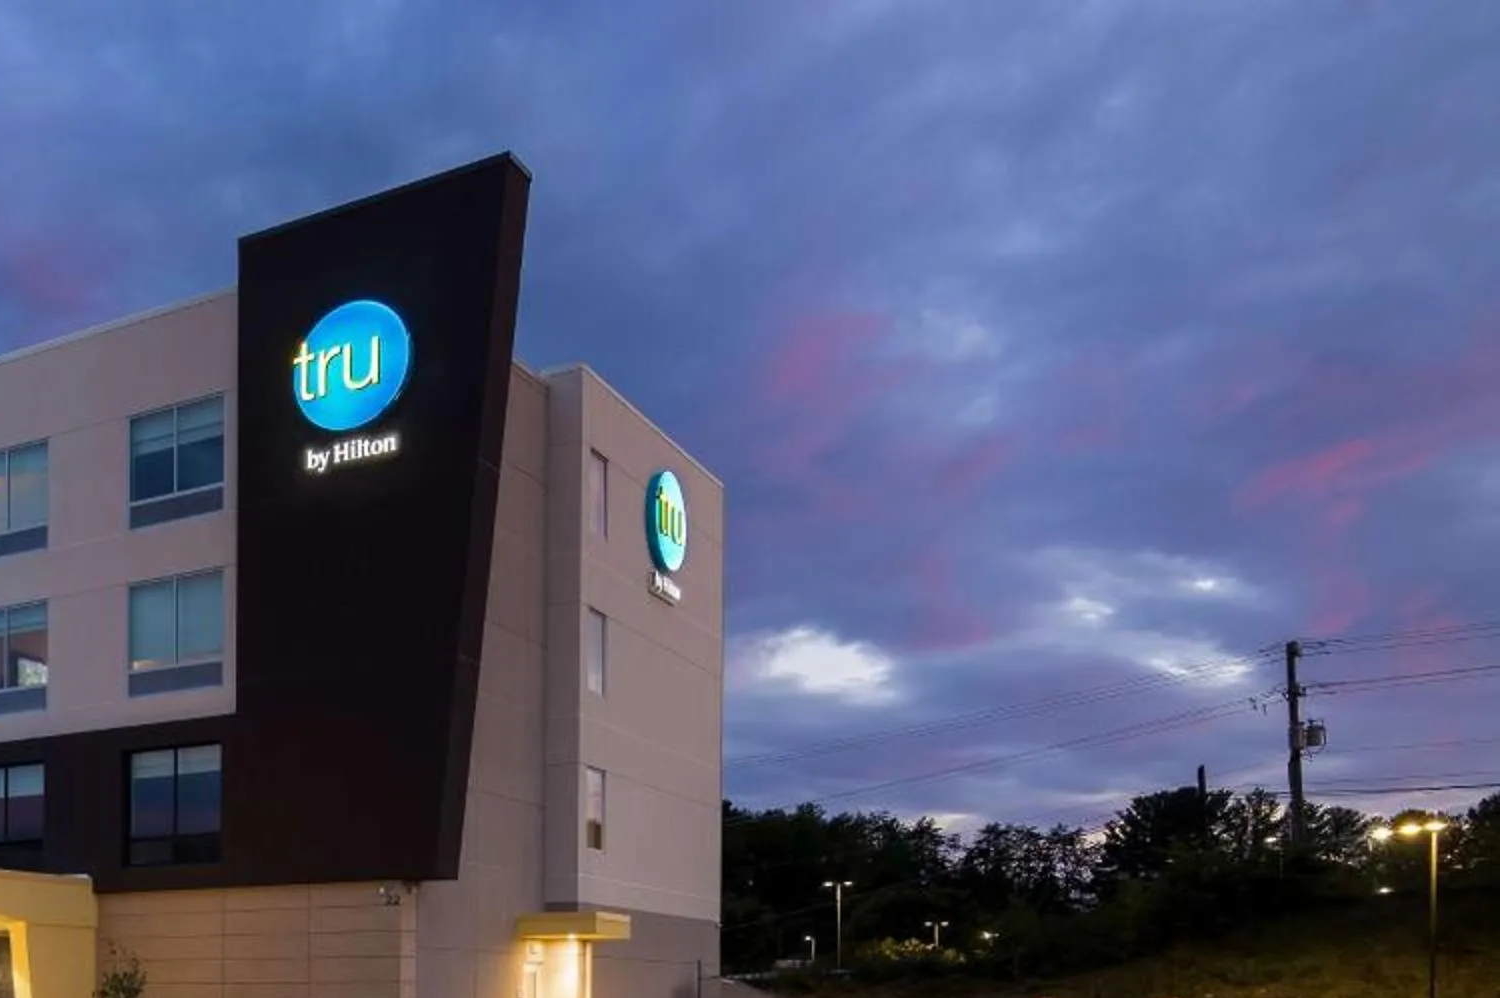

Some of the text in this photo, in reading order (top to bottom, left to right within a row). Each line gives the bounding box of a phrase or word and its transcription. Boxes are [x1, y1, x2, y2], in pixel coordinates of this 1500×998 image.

[293, 335, 381, 401] tru
[306, 436, 397, 473] by Hilton
